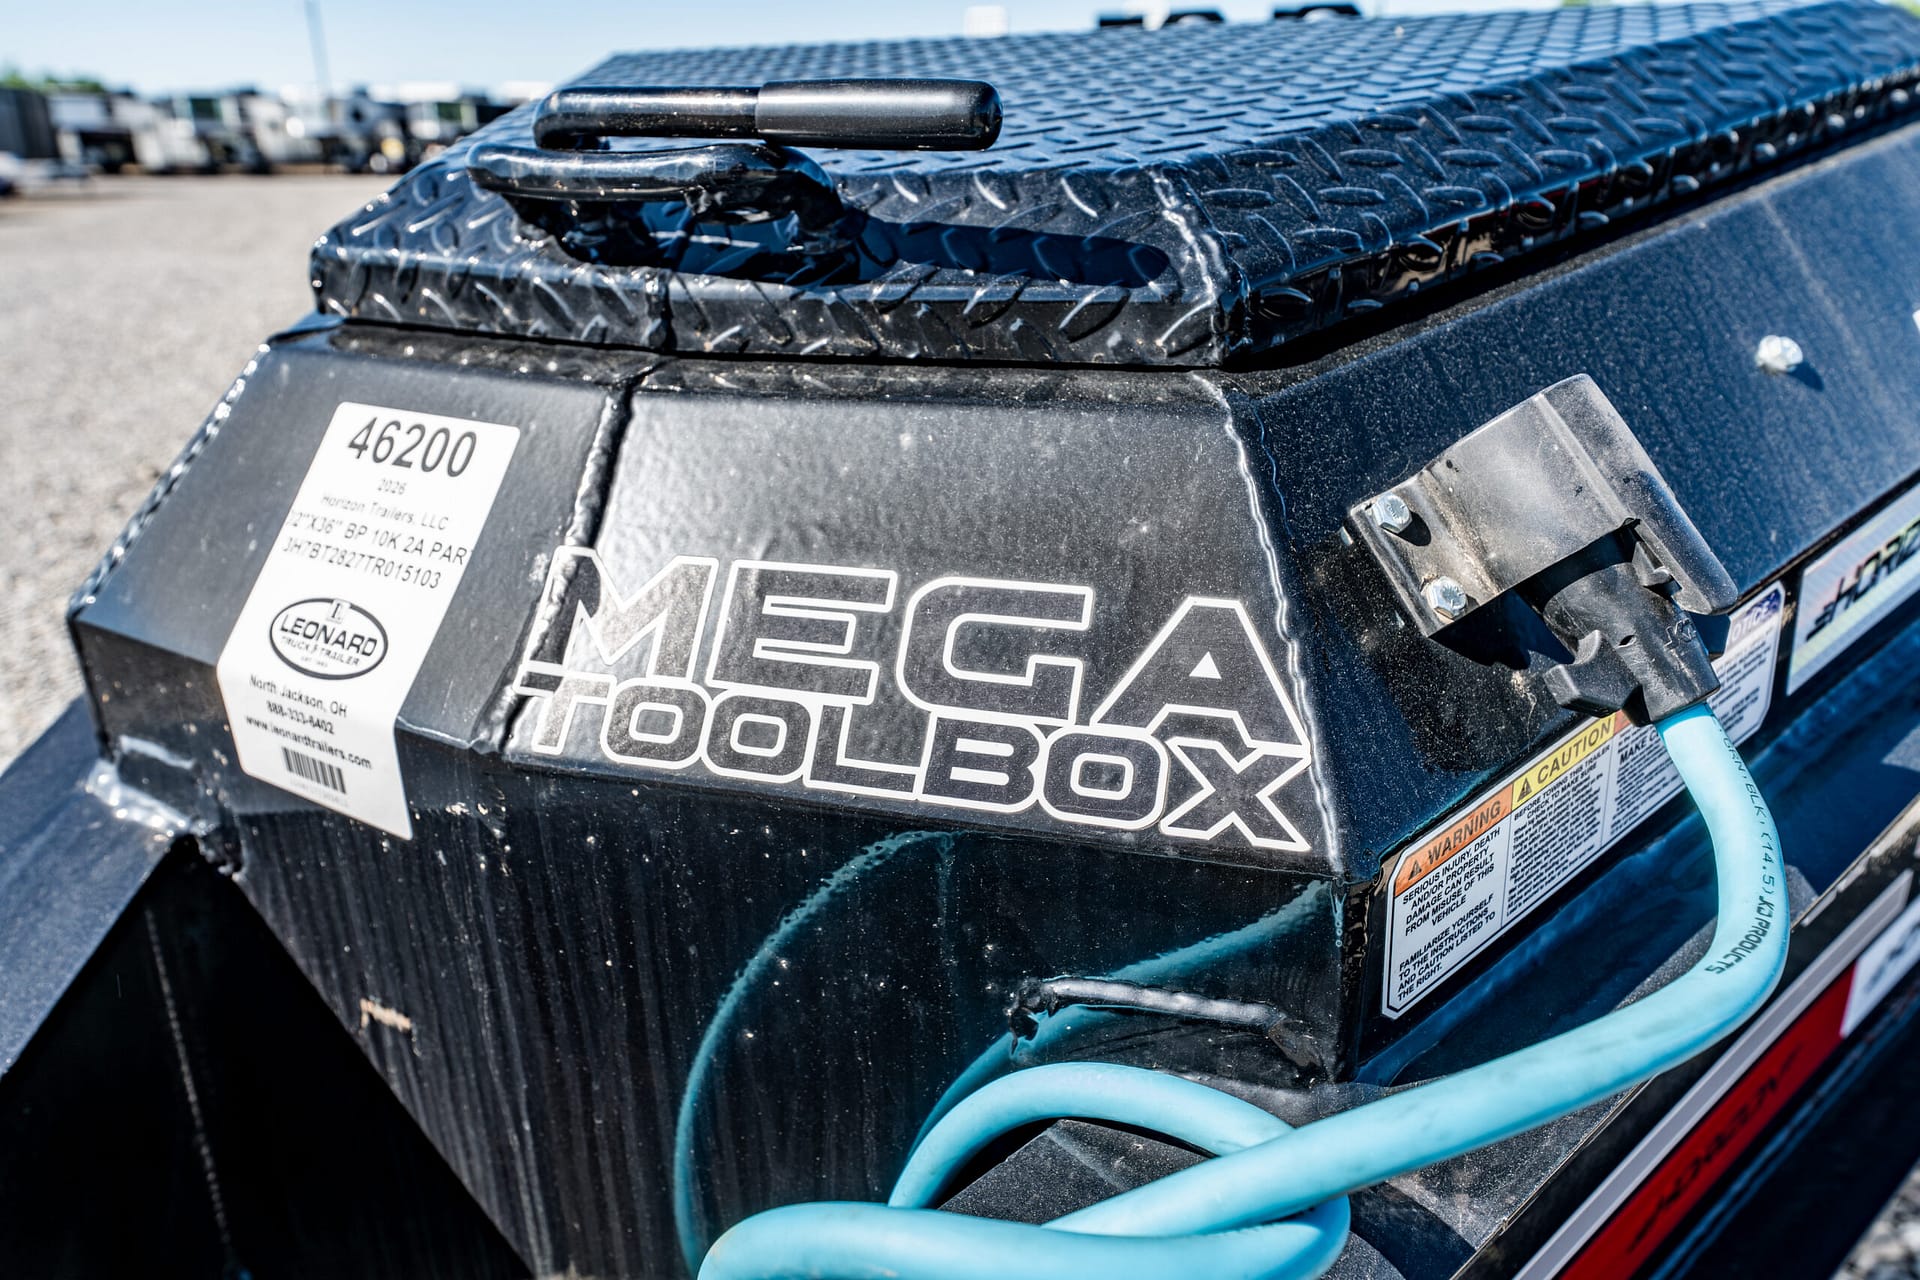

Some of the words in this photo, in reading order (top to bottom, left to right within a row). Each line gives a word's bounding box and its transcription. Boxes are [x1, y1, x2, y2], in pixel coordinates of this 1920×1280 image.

[348, 417, 477, 477] 46200
[344, 522, 368, 540] BP
[374, 529, 402, 550] 10K
[402, 536, 424, 554] 2A
[421, 512, 449, 531] LLC
[280, 614, 378, 657] LEONARD
[518, 546, 1312, 752] MEGA
[250, 674, 277, 695] North
[330, 701, 348, 717] OH
[512, 661, 1312, 853] TOOLBOX
[1537, 718, 1611, 785] CAUTION
[1619, 735, 1648, 765] MAKE
[1514, 796, 1542, 821] BEFORE
[1526, 797, 1550, 819] CHECK
[1551, 790, 1560, 801] TO
[1561, 774, 1580, 794] MAKE
[1580, 761, 1598, 779] SURE
[1428, 800, 1501, 865] WARNING
[1402, 871, 1440, 905] SERIOUS
[1474, 826, 1501, 852] DEATH
[1406, 891, 1443, 925] DAMAGE
[1444, 878, 1462, 896] CAN
[1463, 852, 1495, 882] RESULT
[1411, 880, 1444, 910] AND/OR
[1445, 845, 1489, 885] PROPERTY
[1399, 926, 1451, 973] FAMILIARIZE
[1452, 892, 1495, 931] YOURSELF
[1405, 912, 1430, 937] FROM
[1431, 886, 1463, 917] MISUSE
[1463, 878, 1476, 891] OF
[1477, 863, 1495, 882] THIS
[1431, 894, 1467, 926] VEHICLE
[1397, 973, 1416, 993] AND
[1418, 943, 1455, 976] CAUTION
[1456, 920, 1484, 948] LISTED
[1485, 911, 1496, 924] TO
[1398, 968, 1411, 981] TO
[1412, 953, 1429, 971] THE
[1430, 907, 1489, 957] INSTRUCTIONS
[1397, 982, 1415, 1001] THE
[1416, 962, 1443, 987] RIGHT.
